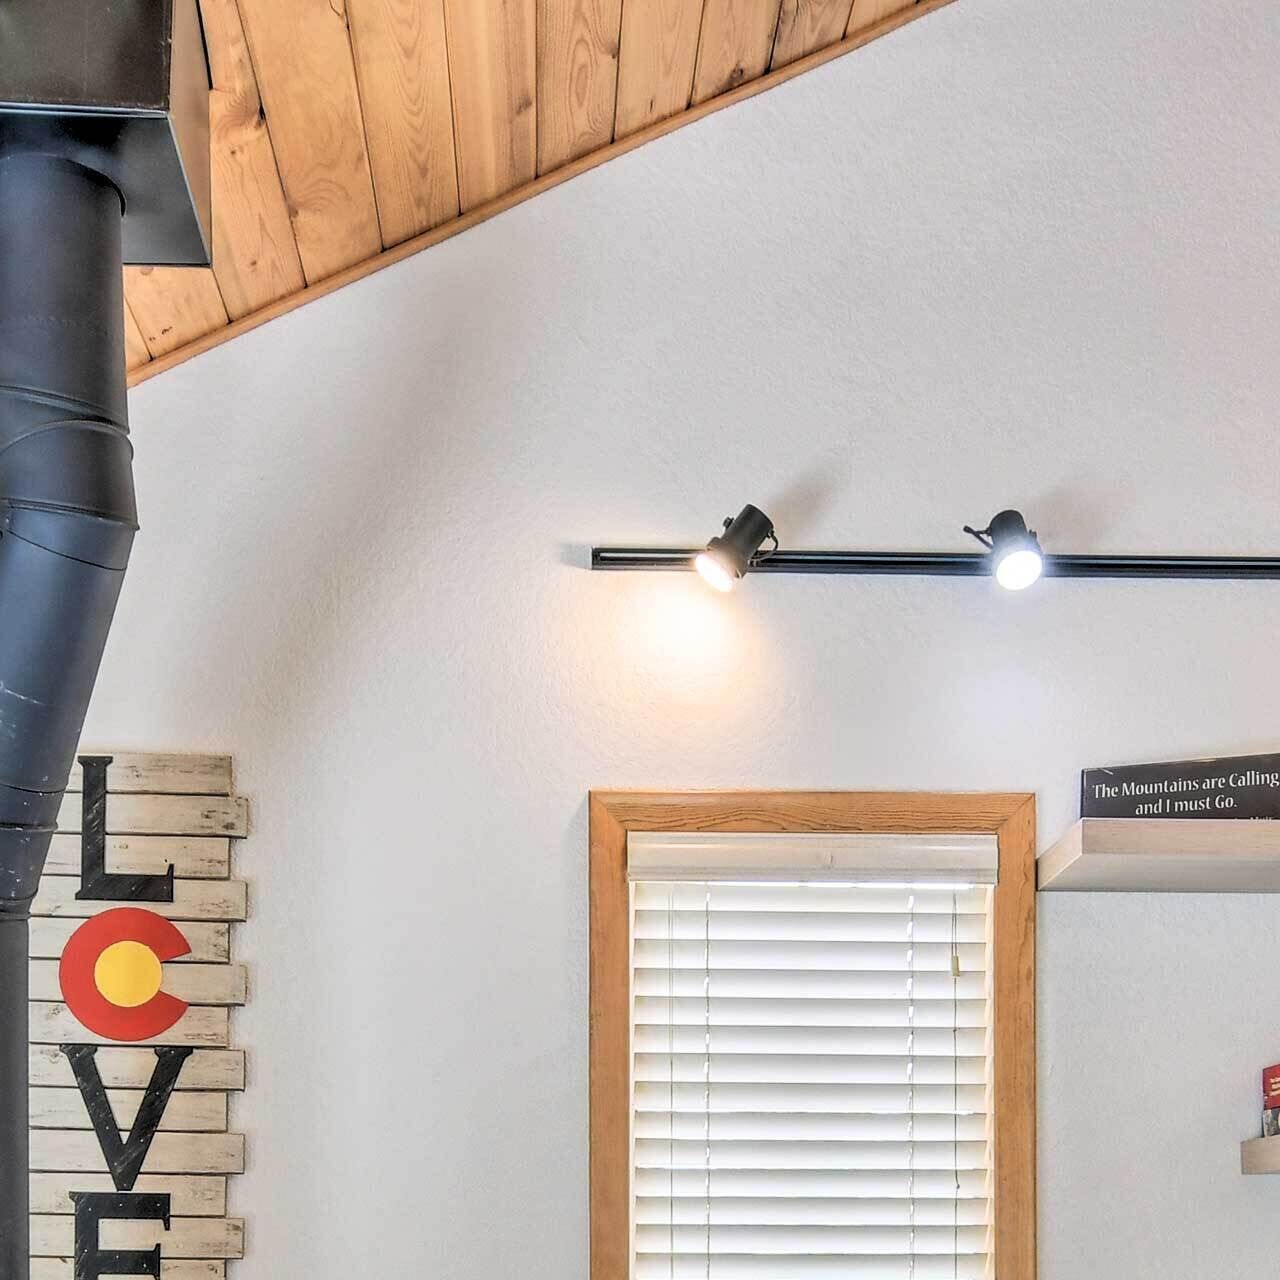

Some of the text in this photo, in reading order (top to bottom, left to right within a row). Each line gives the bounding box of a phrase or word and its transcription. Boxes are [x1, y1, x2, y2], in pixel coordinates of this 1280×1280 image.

[1092, 770, 1280, 799] The Mountains are Calling
[1135, 794, 1238, 815] and I must Go.
